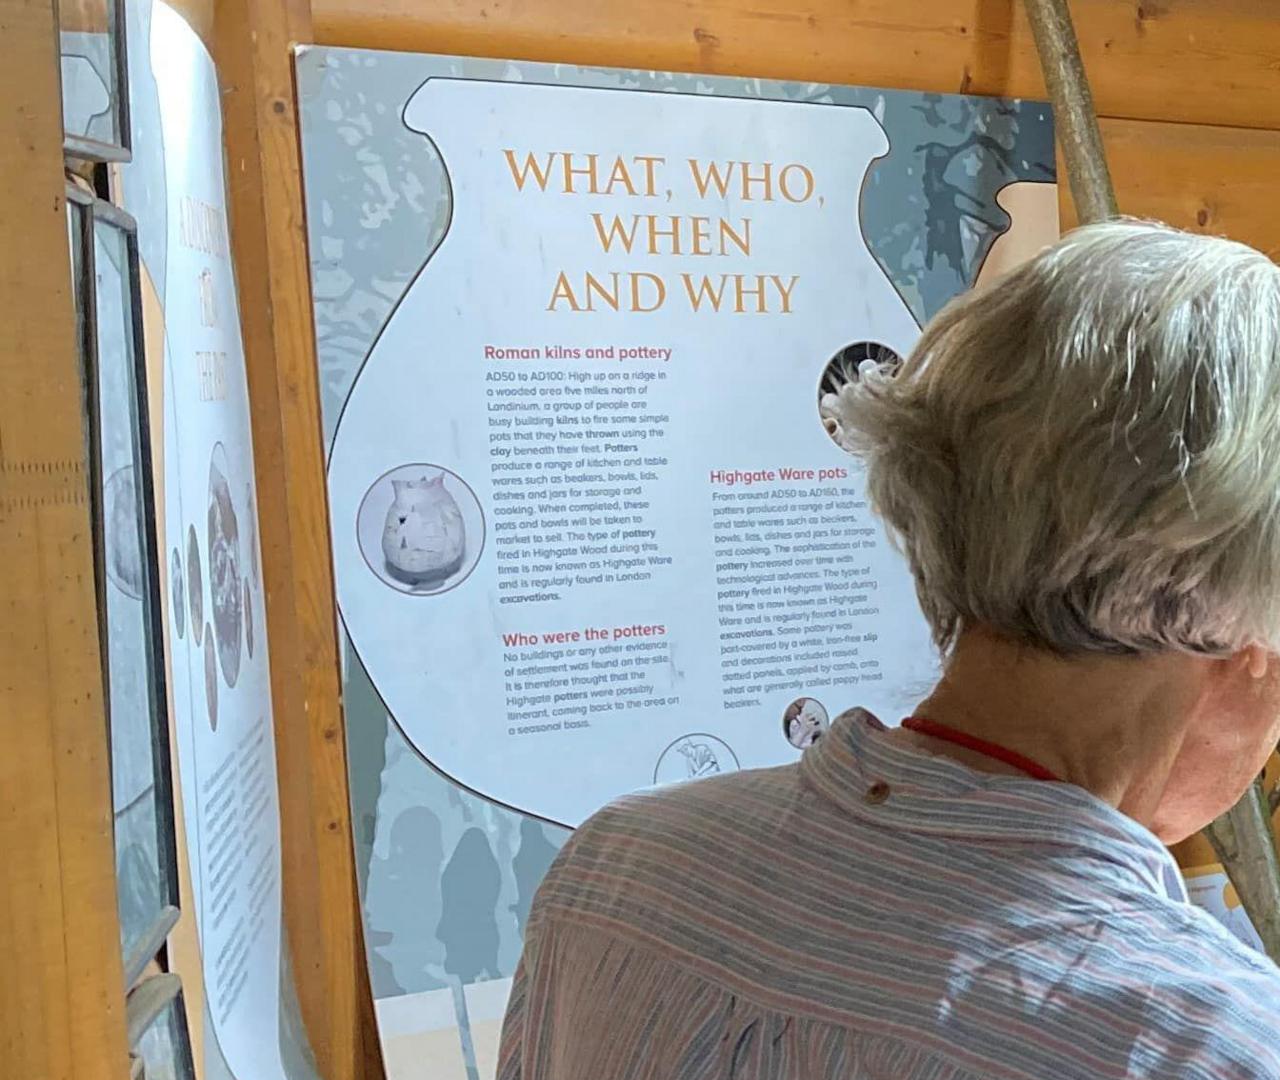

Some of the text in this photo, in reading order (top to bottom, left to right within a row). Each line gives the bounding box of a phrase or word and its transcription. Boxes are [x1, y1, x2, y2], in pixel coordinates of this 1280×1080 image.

[502, 149, 824, 208] WHAT, WHO,
[590, 213, 752, 257] WHEN
[545, 271, 800, 313] AND WHY
[485, 345, 671, 362] Roman kilns and pottery
[486, 372, 515, 380] AD50
[518, 372, 528, 380] to
[568, 371, 591, 382] High
[594, 373, 606, 382] up
[632, 371, 655, 381] ridge
[658, 371, 666, 379] in
[496, 386, 537, 395] wooded
[564, 386, 582, 394] five
[584, 386, 609, 394] miles
[611, 386, 636, 394] north
[638, 385, 647, 394] of
[553, 403, 582, 412] group
[584, 401, 593, 409] of
[596, 400, 628, 411] people
[488, 416, 512, 427] busy
[515, 416, 554, 427] building
[556, 415, 579, 424] kilns
[593, 415, 608, 423] fire
[639, 414, 669, 425] simple
[489, 428, 664, 443] pots that they have thrown using the
[490, 447, 511, 458] clay
[513, 446, 554, 455] beneath
[557, 445, 578, 454] their
[604, 444, 638, 452] Potters
[711, 467, 848, 485] Highgate Ware pots
[503, 622, 665, 647] Who were the potters
